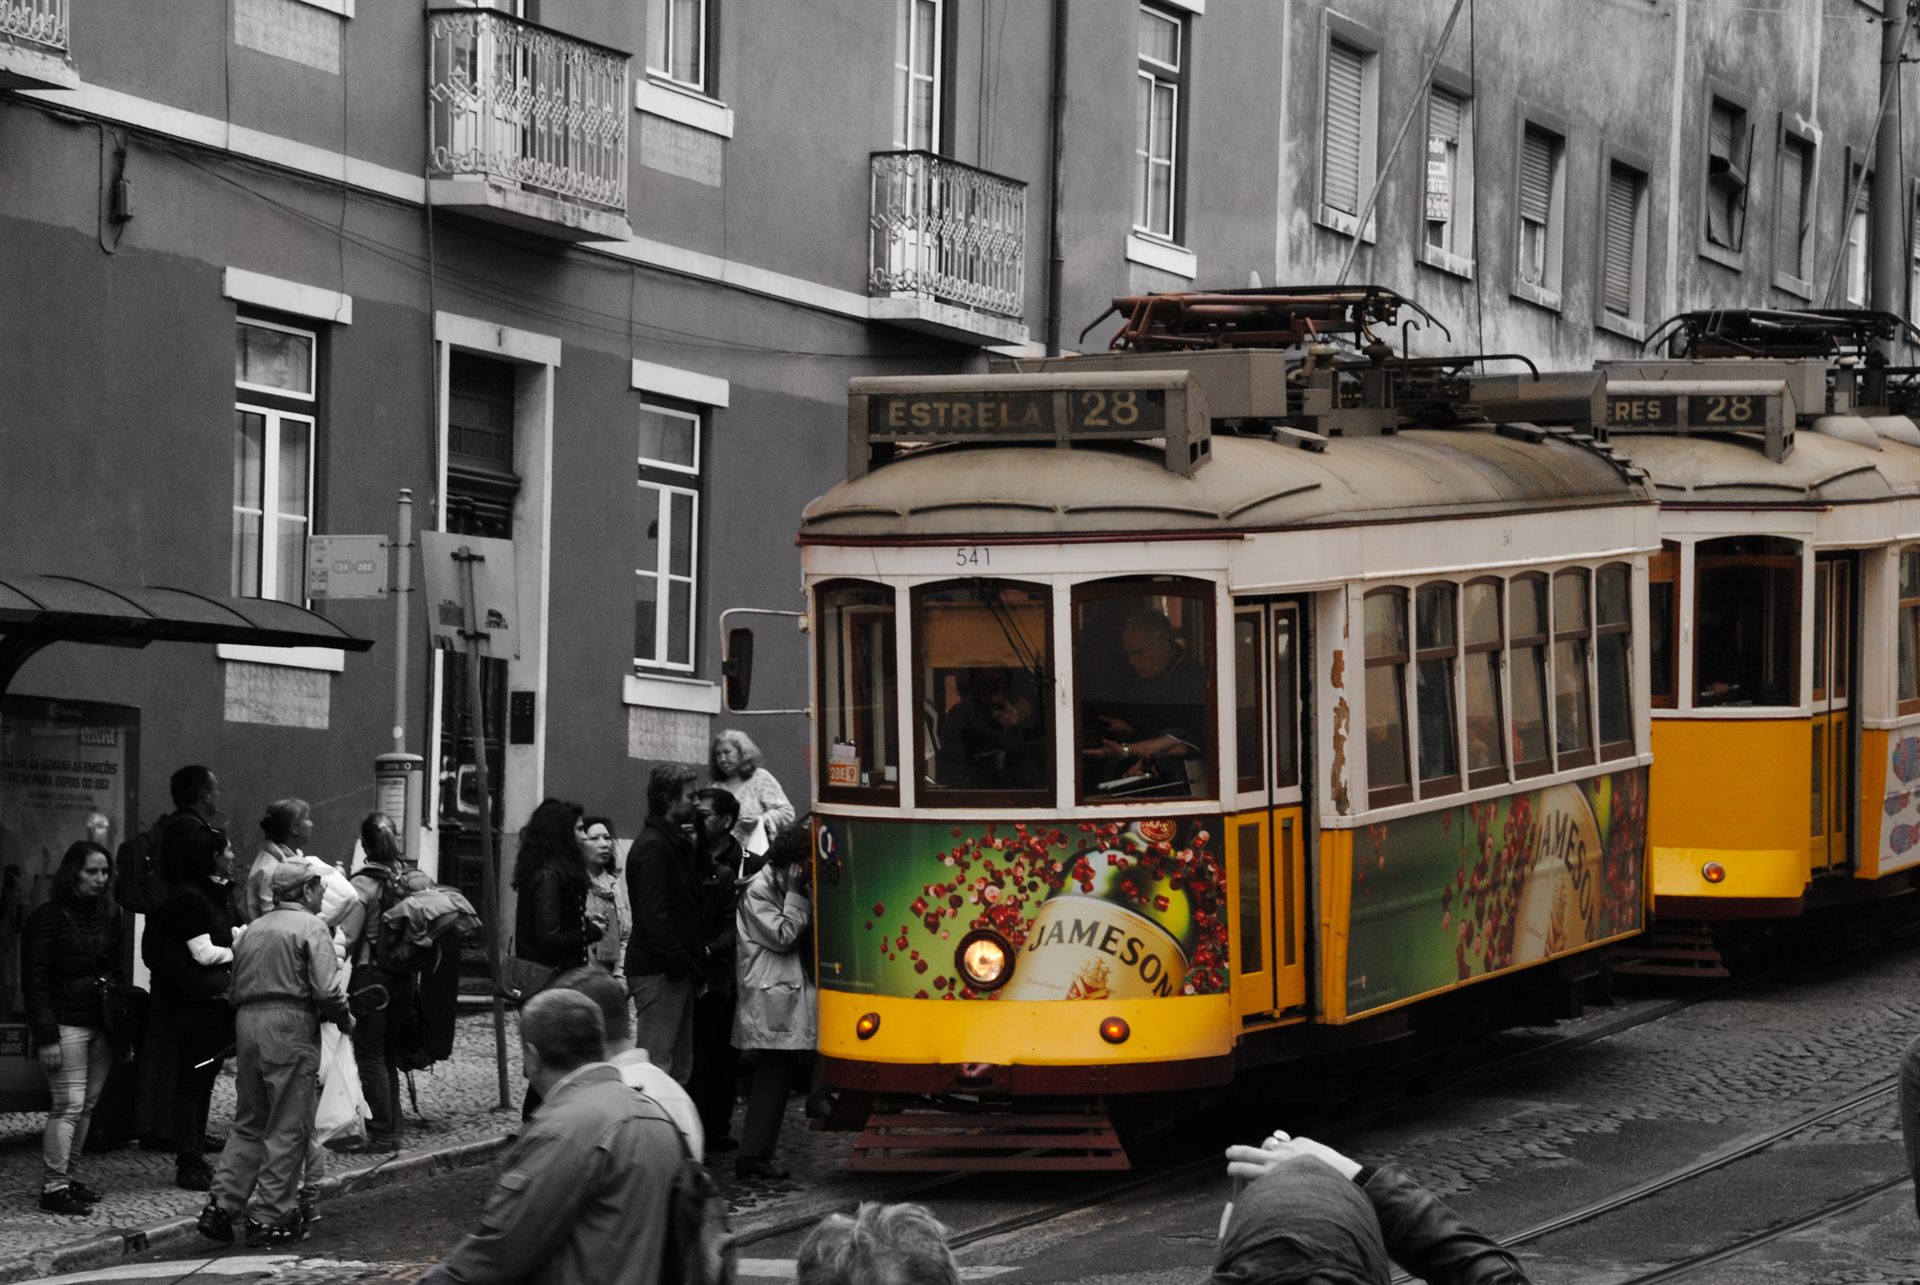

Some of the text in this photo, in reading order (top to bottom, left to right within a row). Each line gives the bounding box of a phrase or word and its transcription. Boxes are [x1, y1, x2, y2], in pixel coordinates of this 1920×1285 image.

[888, 392, 1139, 427] ESTRELA 28
[1706, 397, 1752, 422] 28
[956, 548, 990, 566] 541
[1530, 809, 1595, 942] JAMESON
[1028, 918, 1173, 998] JAMESON
